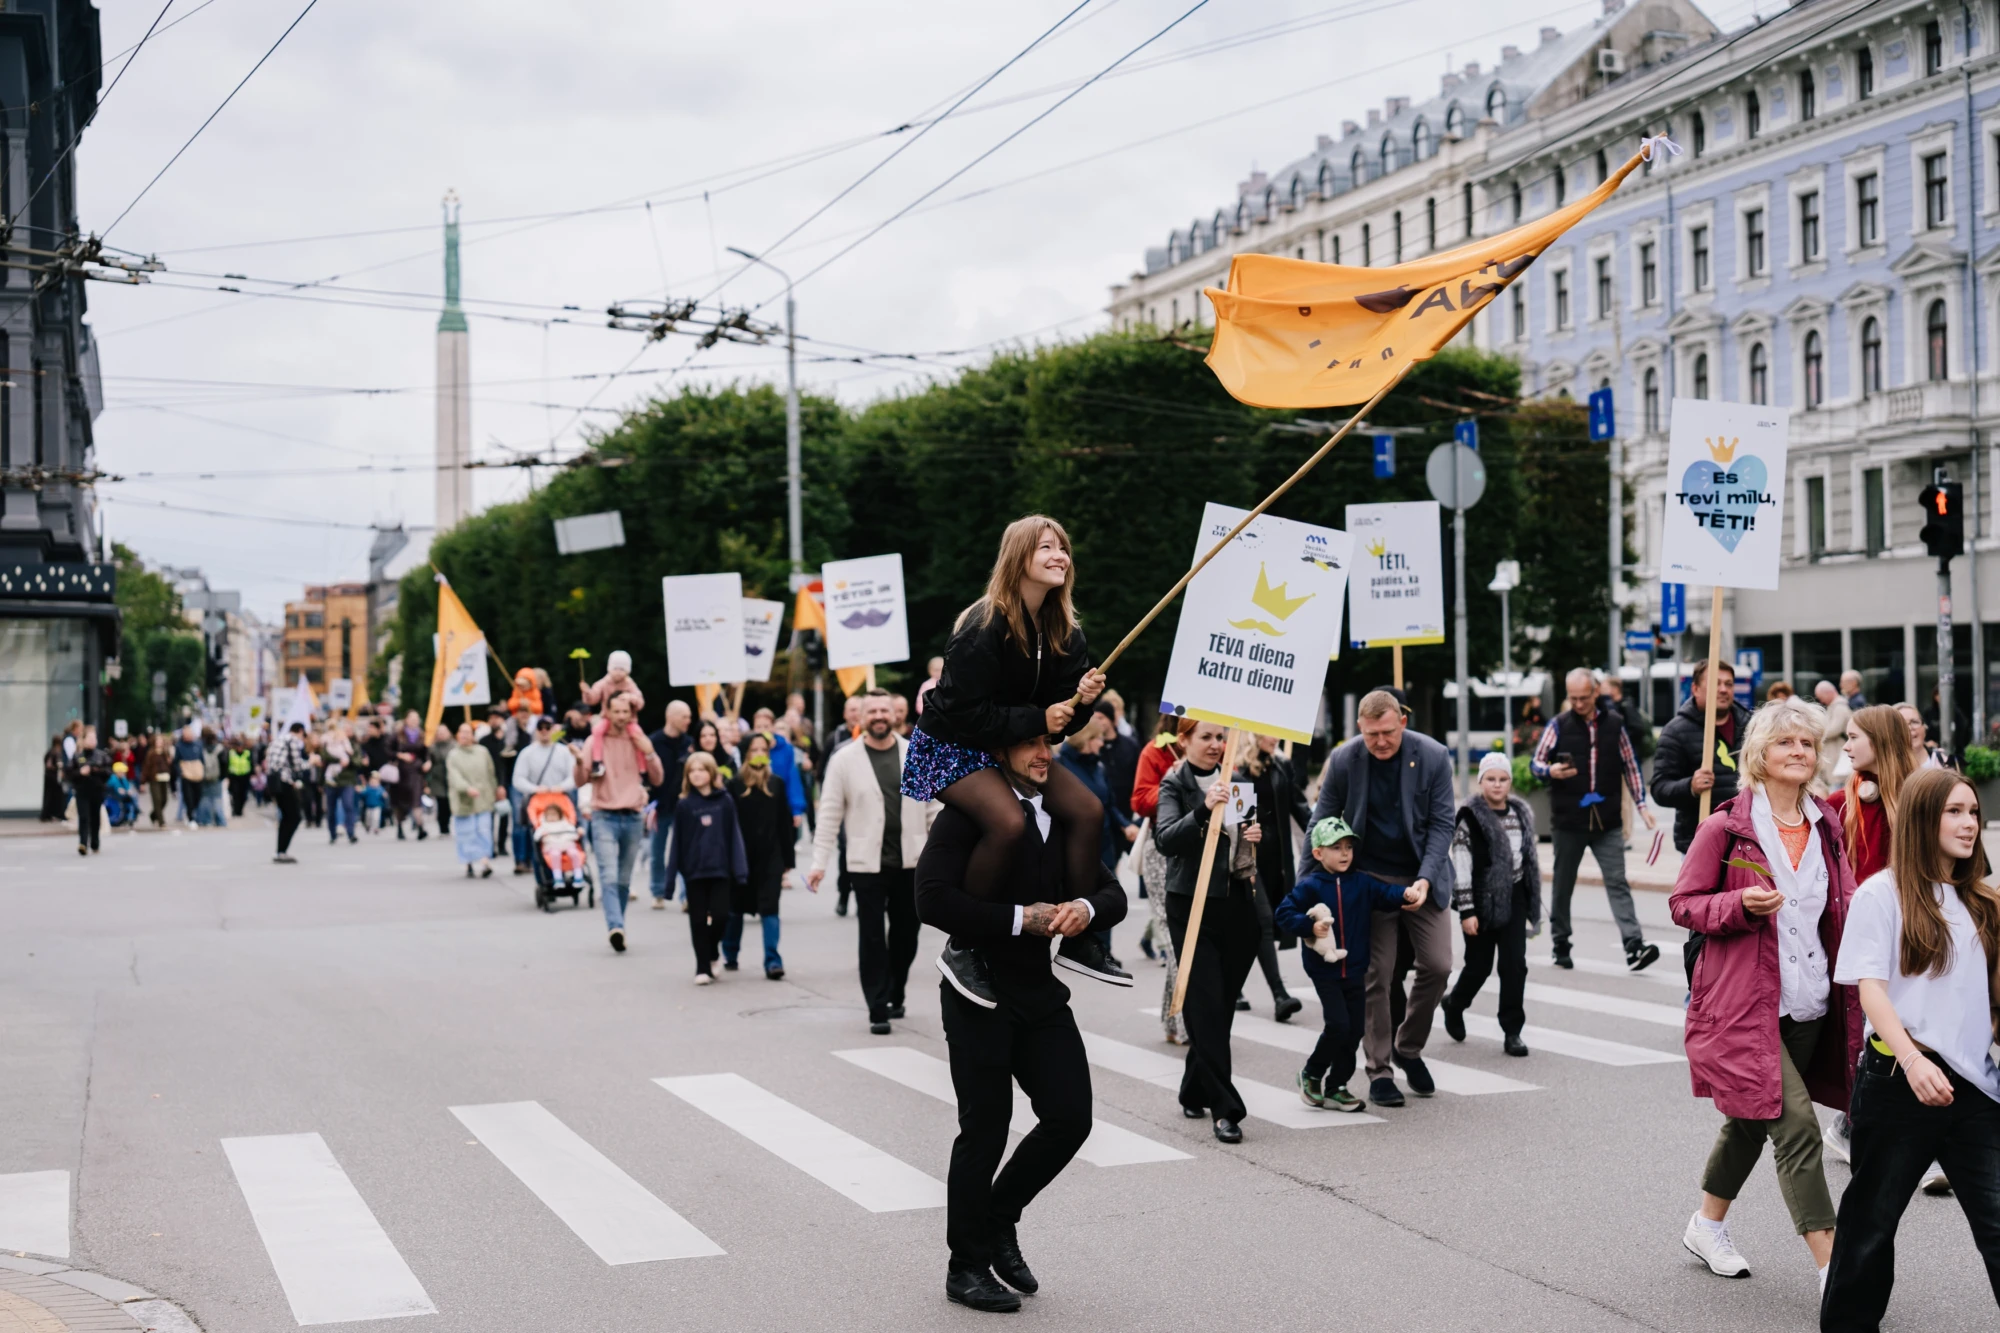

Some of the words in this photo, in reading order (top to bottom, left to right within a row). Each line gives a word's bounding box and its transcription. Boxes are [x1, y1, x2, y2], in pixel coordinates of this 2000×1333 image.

[1712, 471, 1739, 484] Es
[1675, 490, 1720, 505] Tevi
[1727, 489, 1776, 507] mīlu,
[1693, 509, 1755, 531] TĒTI!
[1378, 551, 1410, 571] TĒTI,
[1408, 574, 1419, 584] ka
[1370, 589, 1381, 600] Tu
[1383, 589, 1402, 599] man
[1208, 632, 1245, 659] TĒVA
[1248, 643, 1296, 670] diena
[1197, 656, 1243, 684] katru
[1246, 667, 1295, 695] dienu
